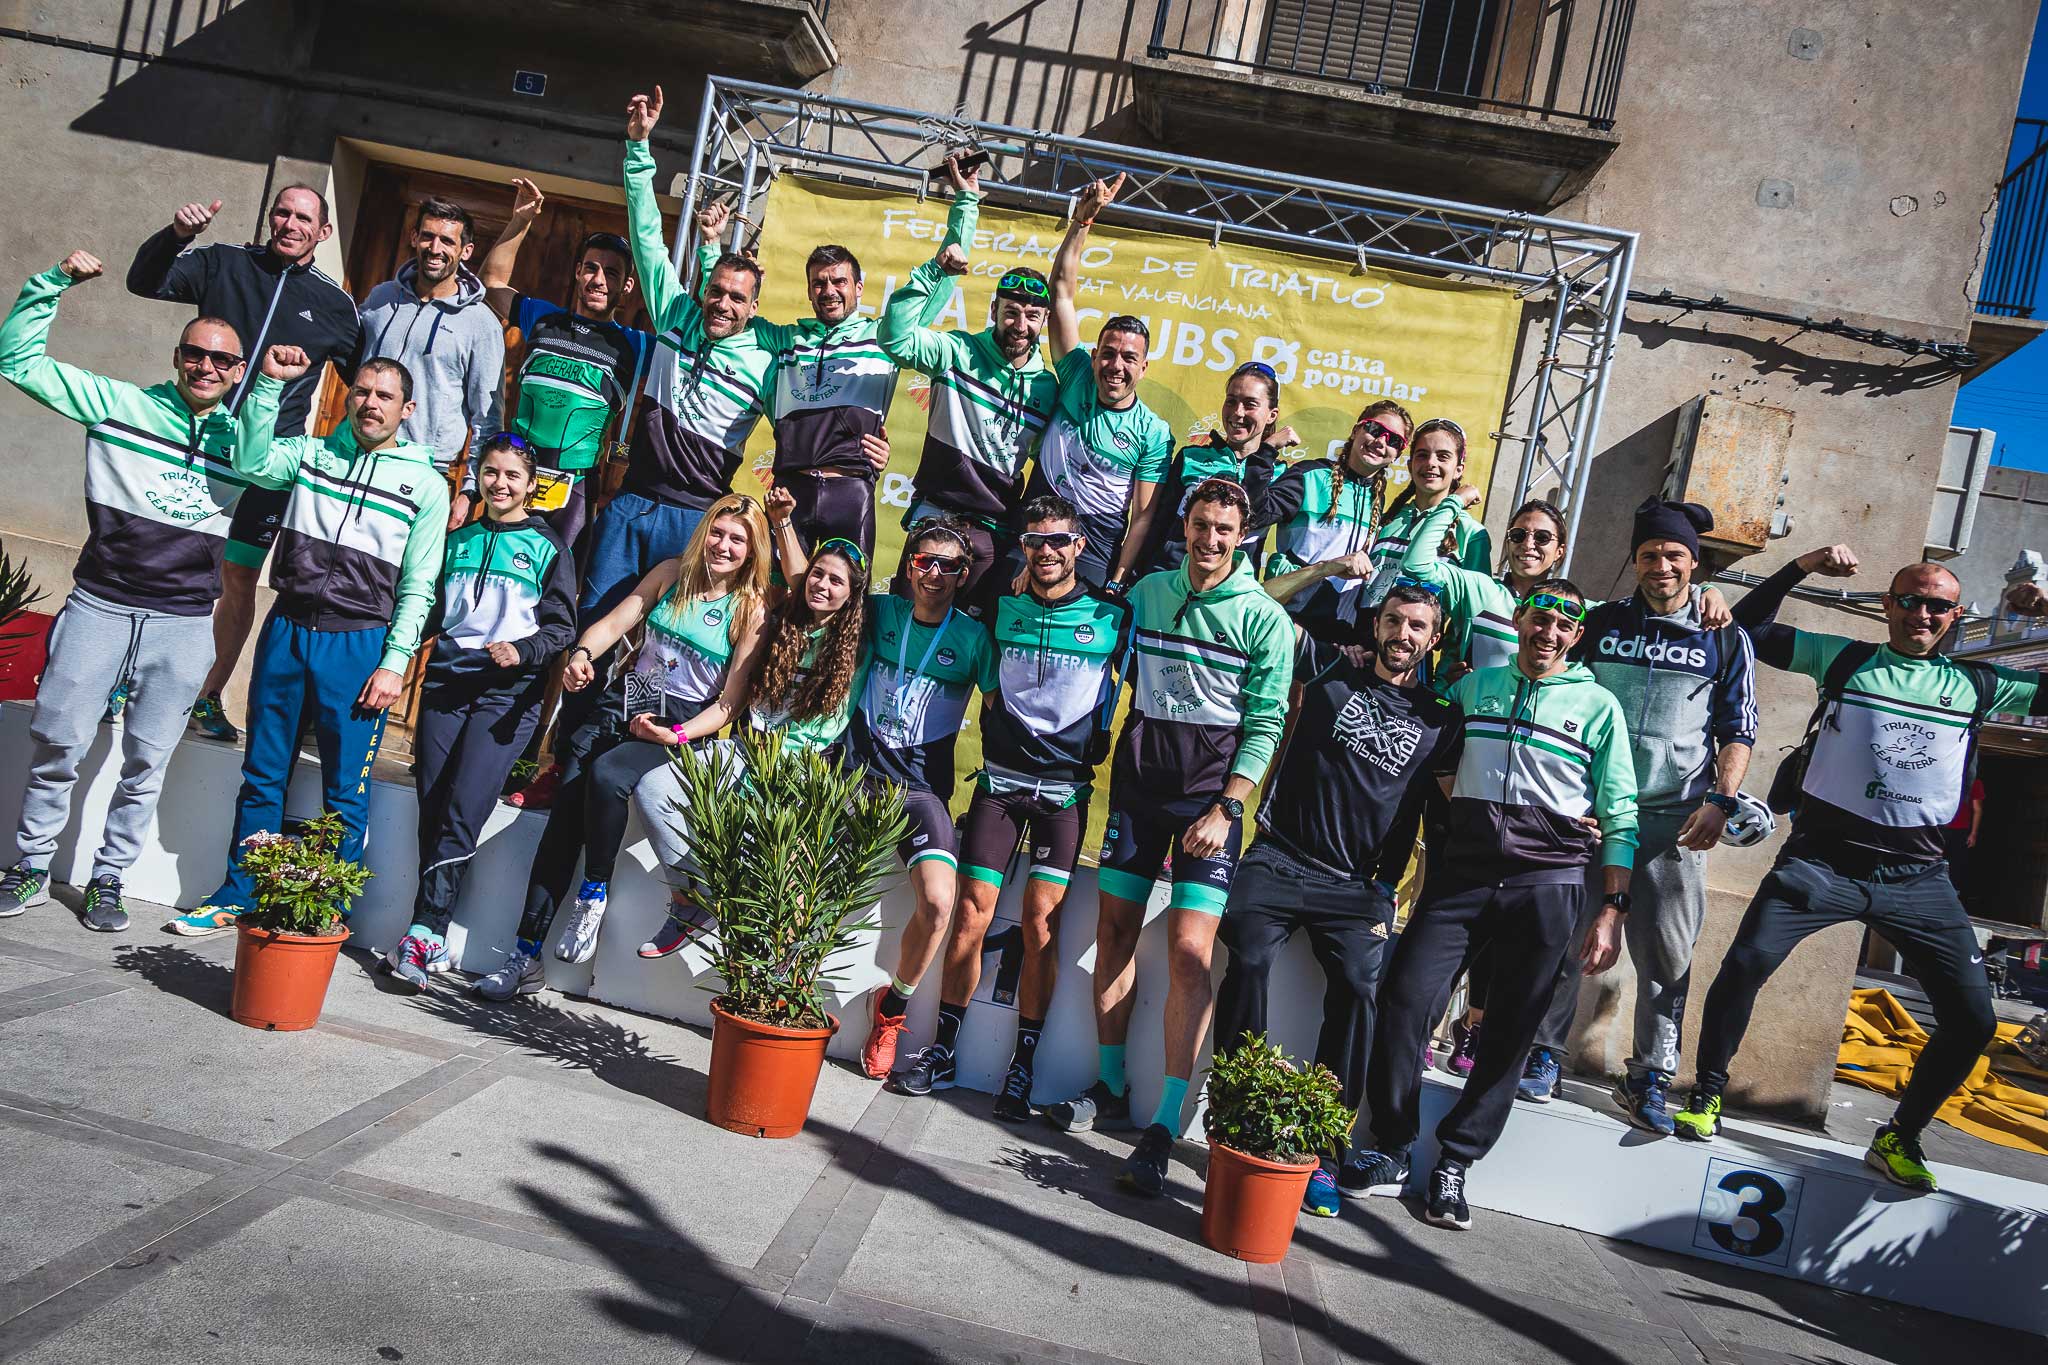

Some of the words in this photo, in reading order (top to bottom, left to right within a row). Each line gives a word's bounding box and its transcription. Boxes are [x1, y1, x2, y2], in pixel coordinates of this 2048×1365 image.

[525, 76, 534, 90] 5
[1140, 256, 1197, 278] DE
[1224, 262, 1392, 308] TRIATLÓ
[1120, 283, 1273, 320] VALENCIANA
[1306, 348, 1386, 376] caixa
[1302, 367, 1428, 403] popular
[1004, 647, 1028, 665] CEA
[1599, 635, 1707, 669] adidas
[1895, 755, 1938, 770] BÉTERA
[1878, 788, 1923, 804] PULGADAS
[982, 924, 1025, 1007] 1
[1662, 995, 1685, 1072] adidas
[1707, 1169, 1787, 1257] 3
